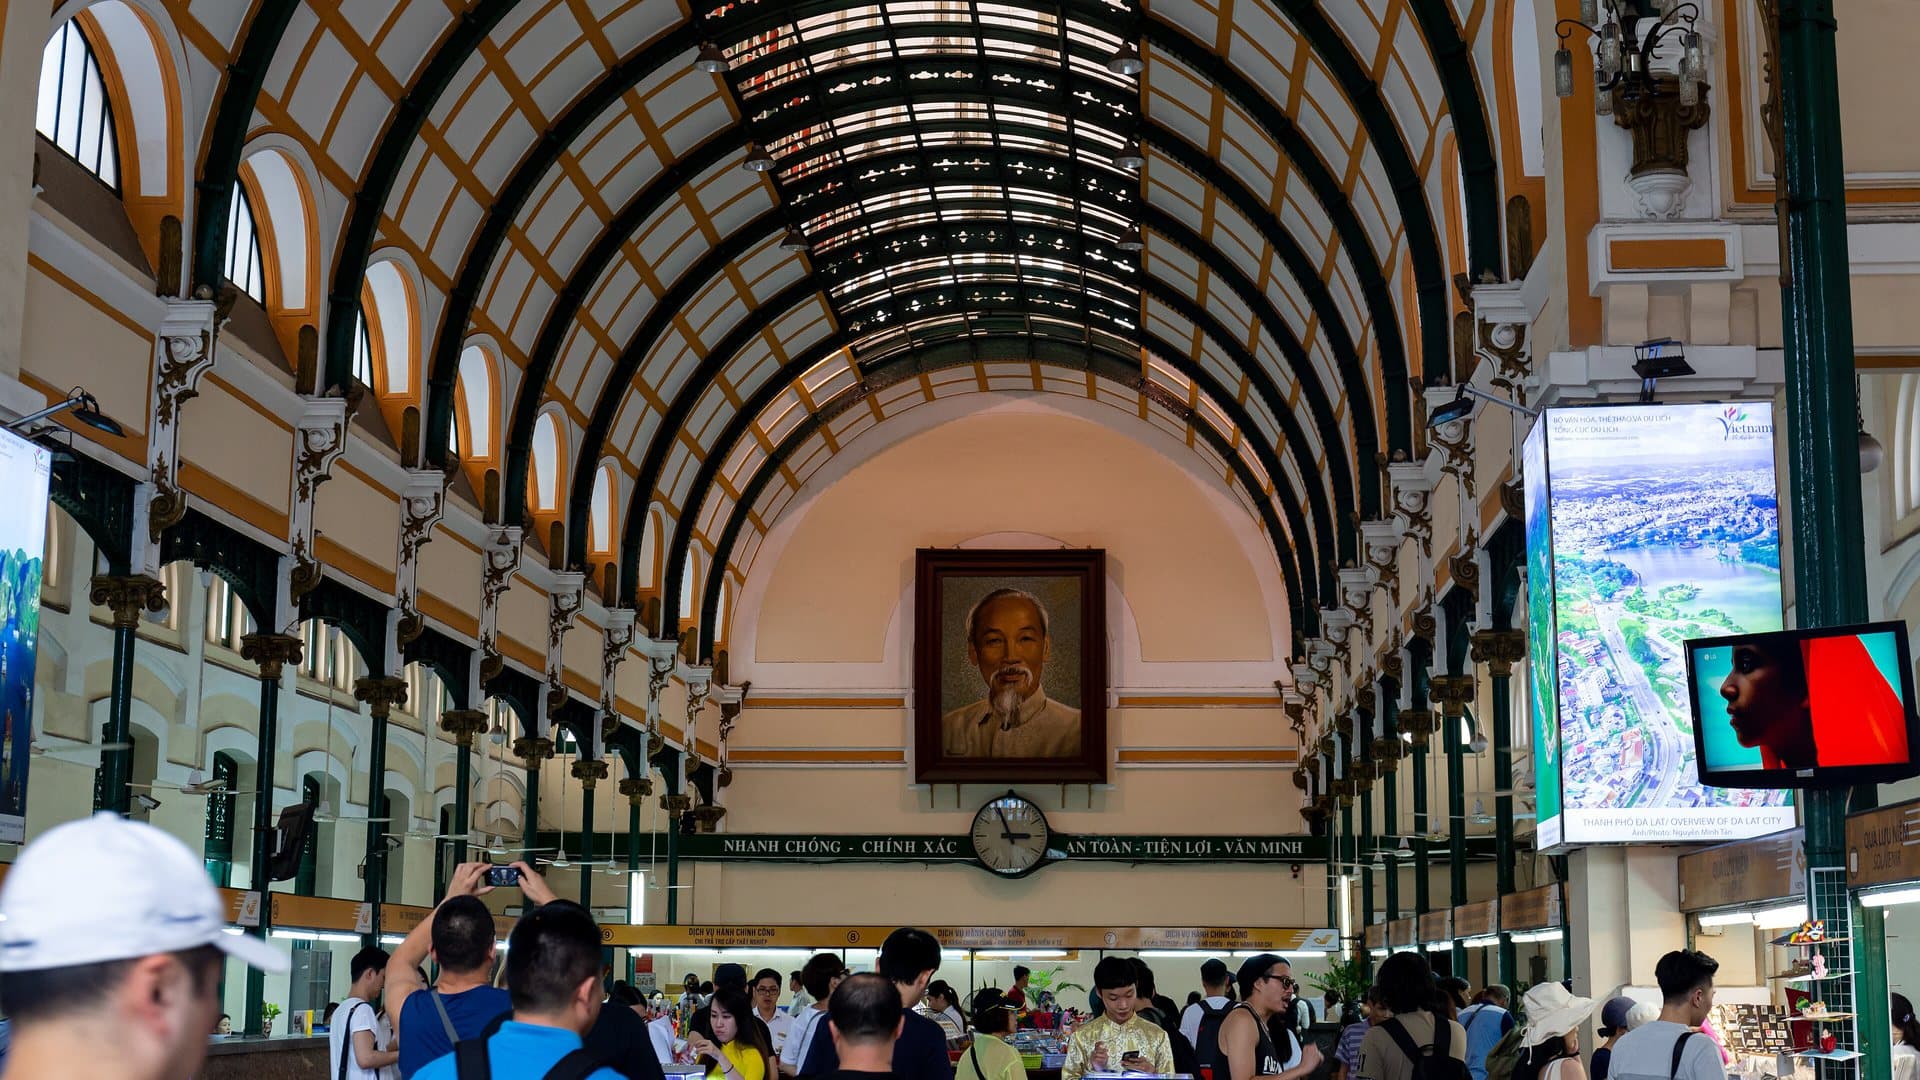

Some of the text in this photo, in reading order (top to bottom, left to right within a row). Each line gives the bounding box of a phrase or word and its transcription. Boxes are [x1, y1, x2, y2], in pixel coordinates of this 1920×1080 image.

[1716, 417, 1773, 440] Vietnam
[1670, 816, 1715, 826] OVERVIEW
[1717, 816, 1729, 825] OF
[1746, 816, 1761, 825] LAT
[1763, 816, 1782, 825] CITY
[724, 839, 779, 852] NHANH
[785, 836, 841, 853] CHÓNG
[862, 837, 916, 854] CHÍNH
[923, 838, 957, 854] XÁC
[1066, 841, 1087, 854] AN
[1090, 838, 1132, 854] TOÀN
[1144, 838, 1184, 857] TIỆN
[1185, 840, 1212, 857] LỢI
[1224, 838, 1259, 854] VĂN
[1261, 841, 1303, 854] MINH
